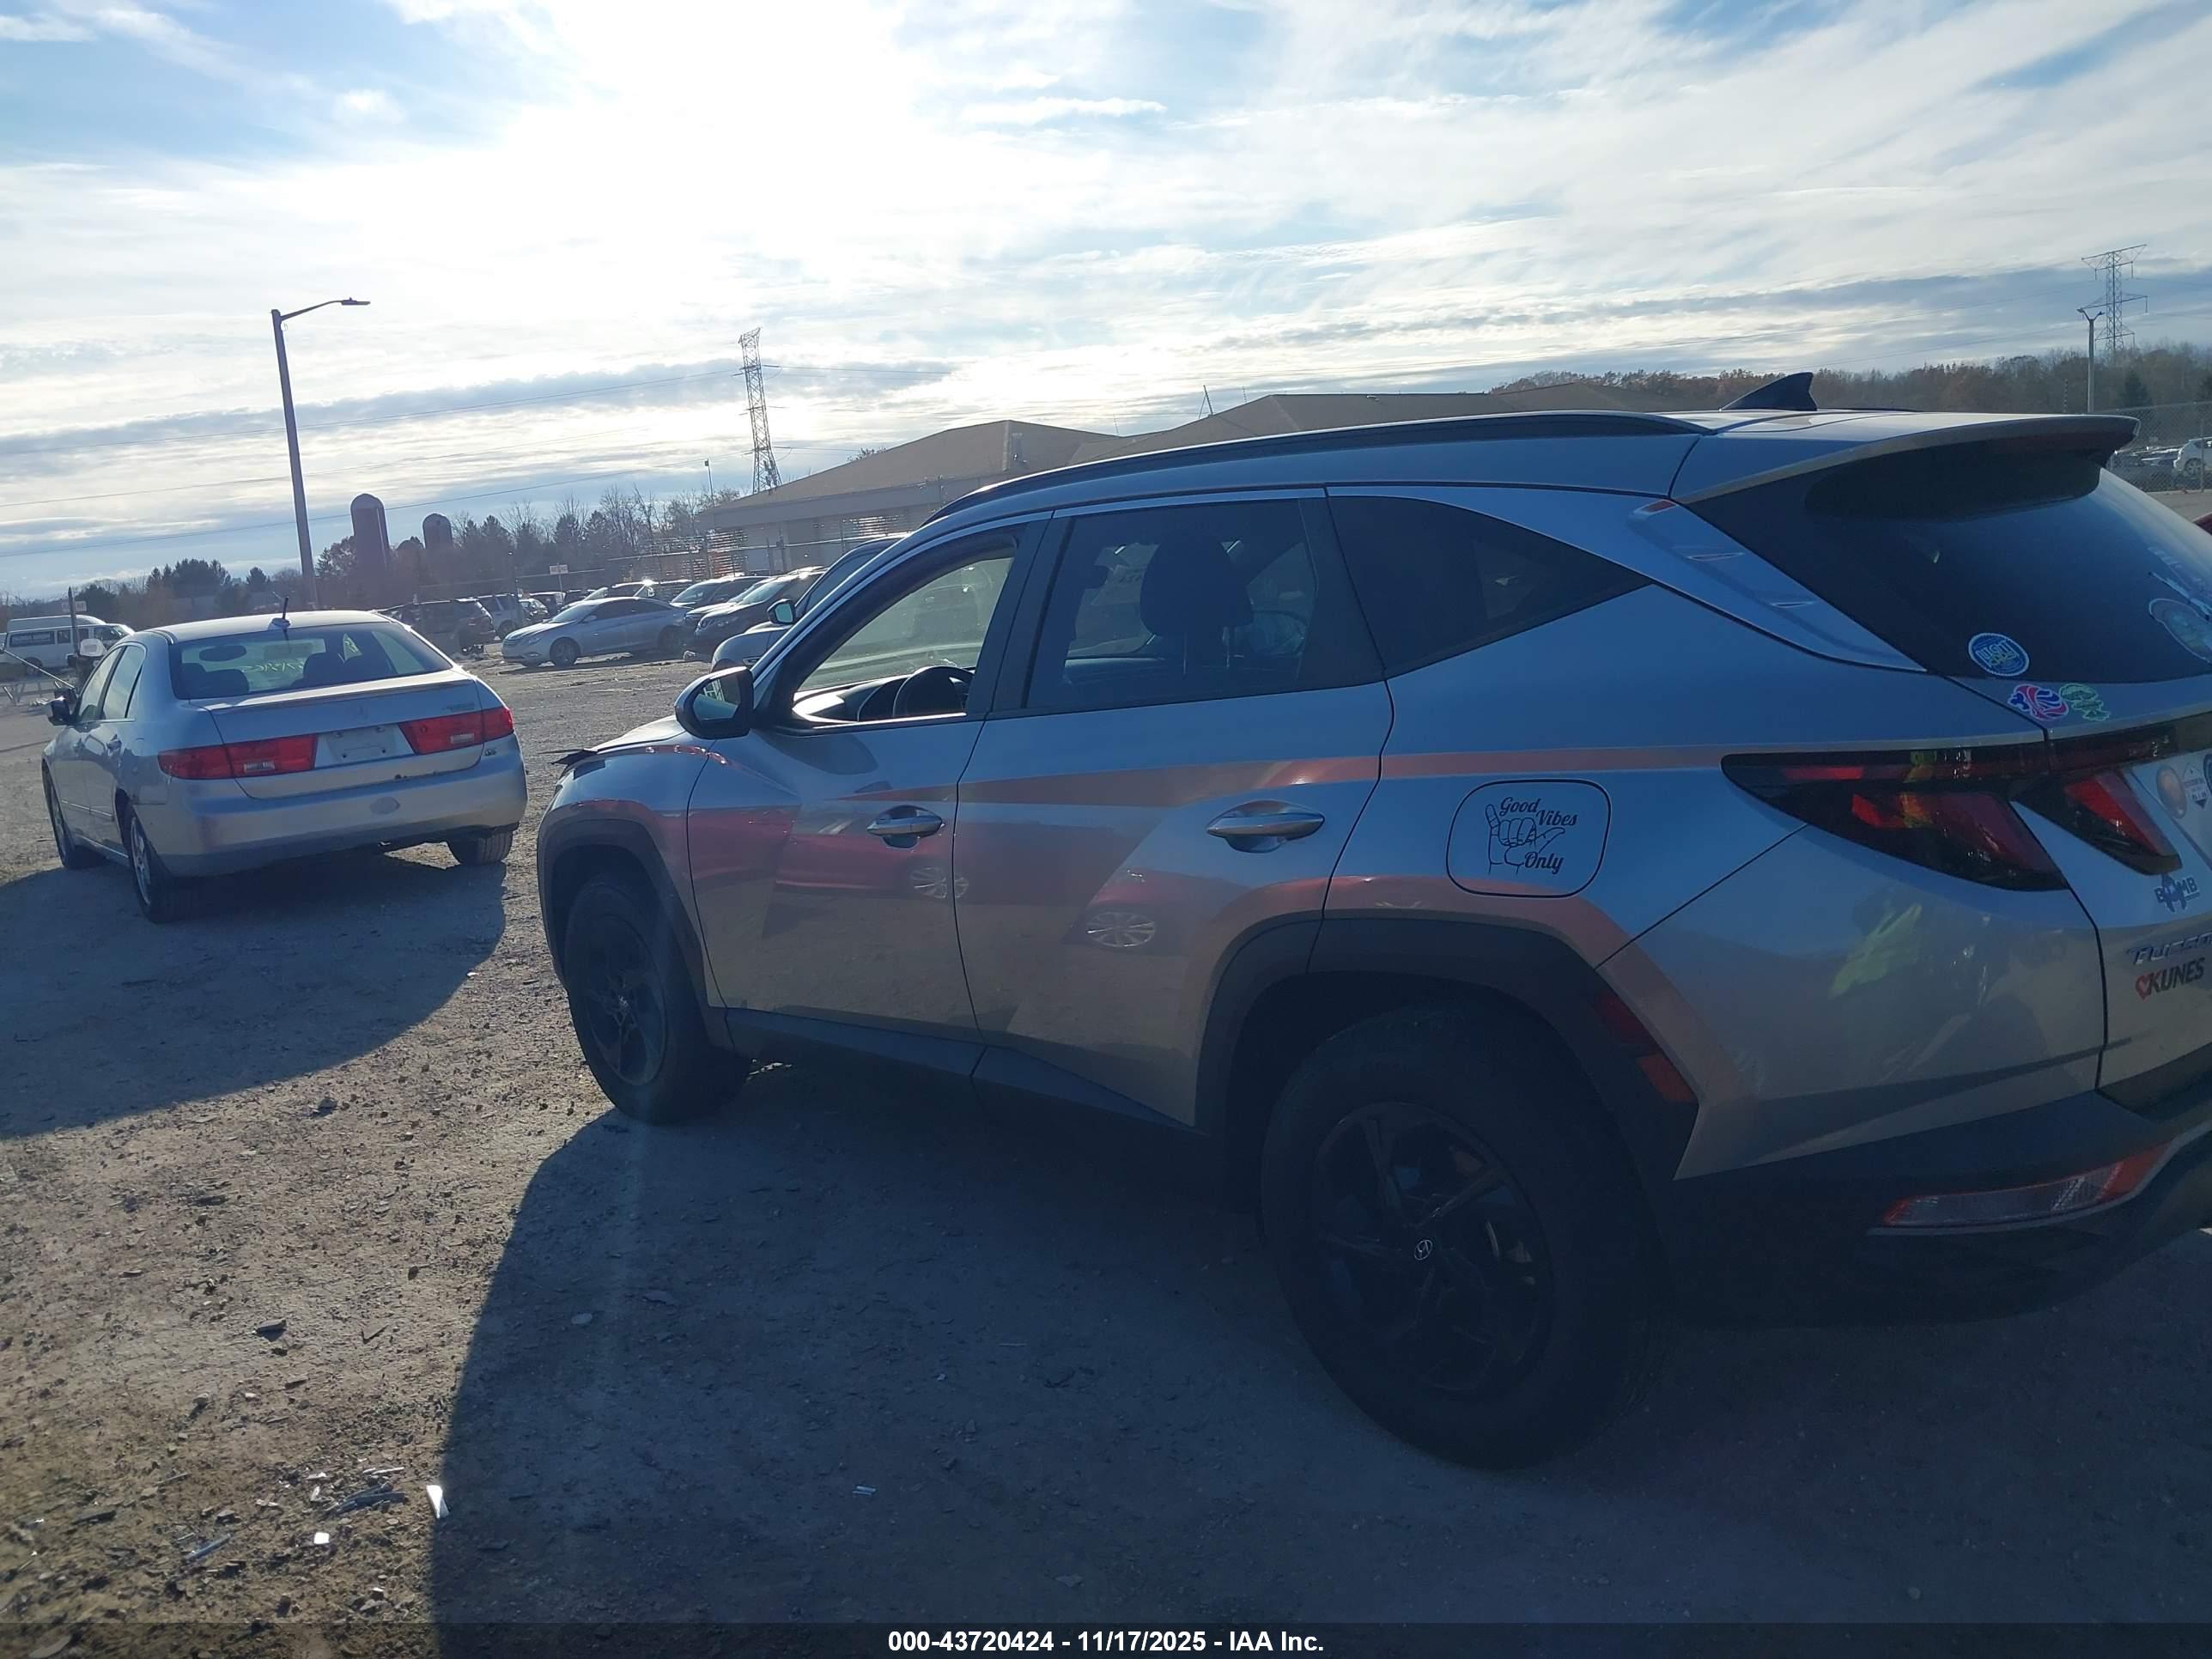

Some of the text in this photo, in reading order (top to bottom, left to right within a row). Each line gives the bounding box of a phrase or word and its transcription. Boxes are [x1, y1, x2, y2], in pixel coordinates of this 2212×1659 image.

[1499, 797, 1541, 816] Good
[1536, 810, 1578, 826] Vibes
[1524, 852, 1565, 874] Only
[2154, 877, 2199, 903] BMB
[2148, 957, 2205, 994] KUNES
